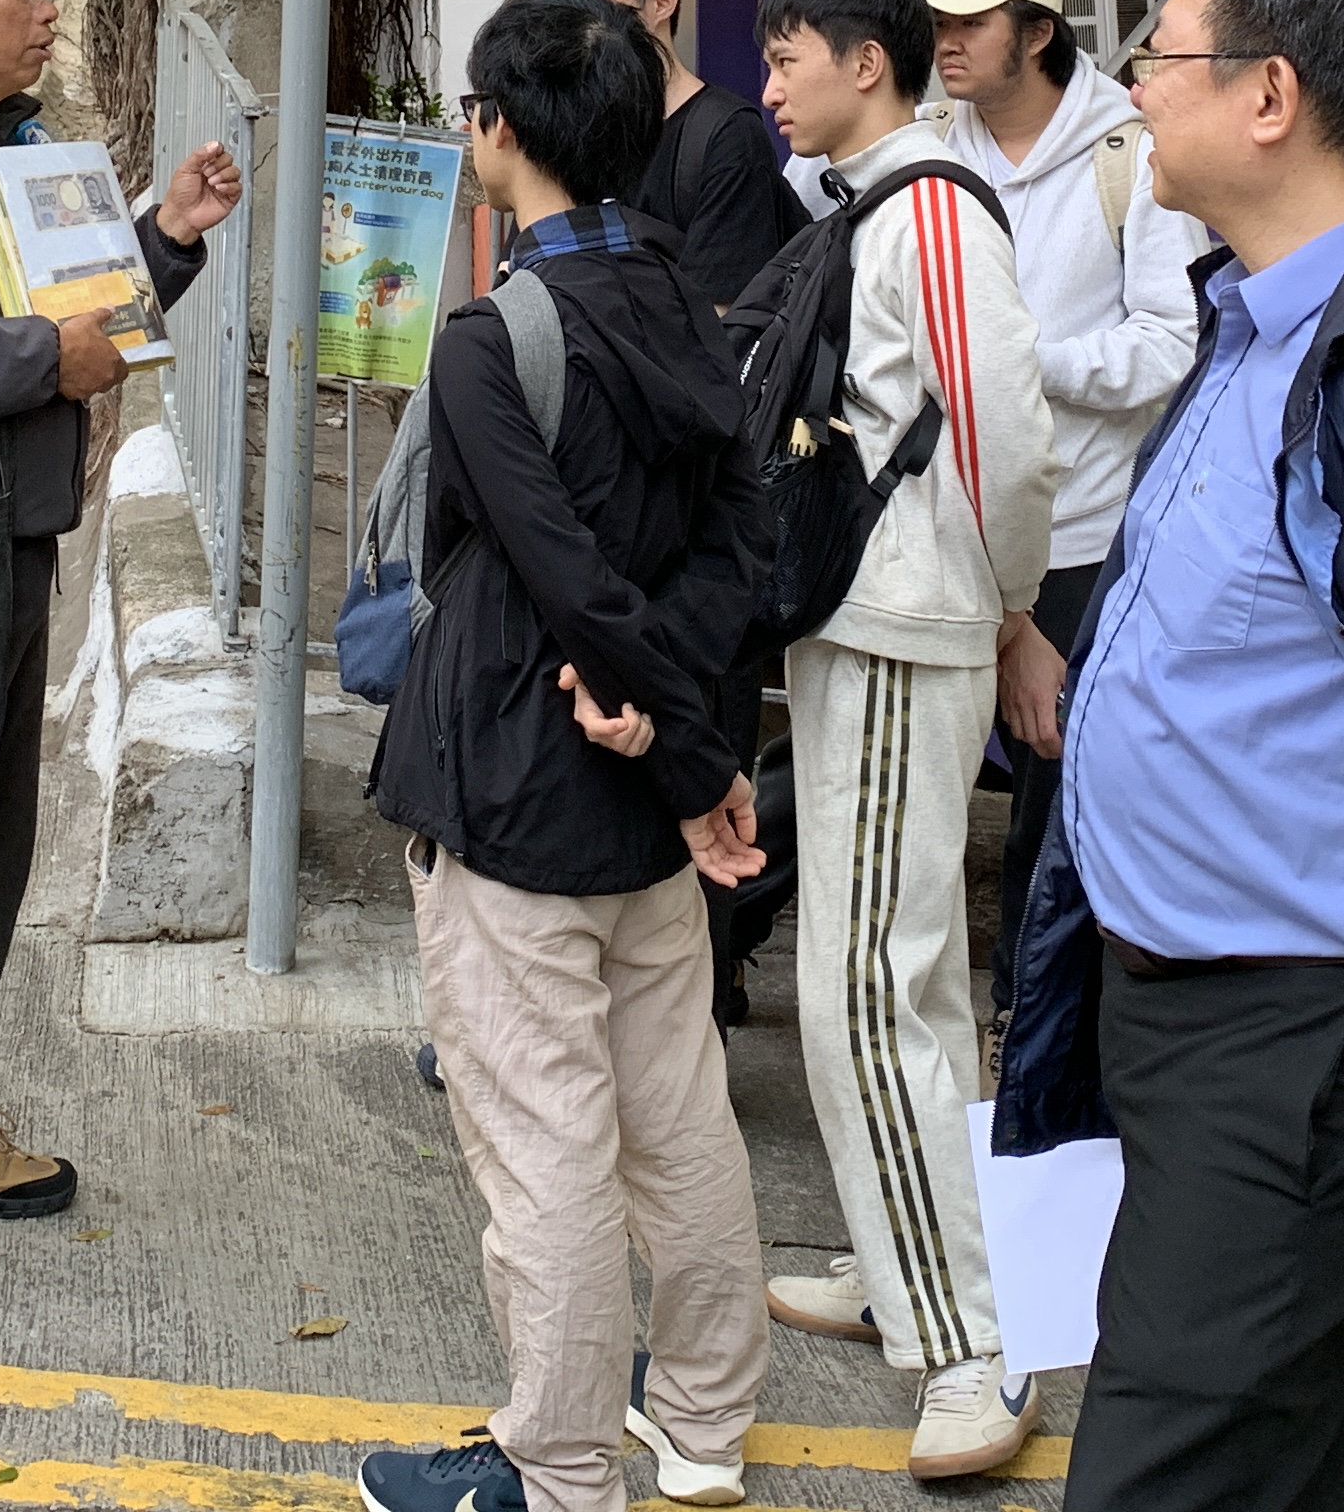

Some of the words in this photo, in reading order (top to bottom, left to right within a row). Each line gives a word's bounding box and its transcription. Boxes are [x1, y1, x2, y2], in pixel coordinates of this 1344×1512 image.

[334, 178, 351, 187] up
[354, 181, 388, 191] after
[389, 185, 418, 195] your
[421, 188, 444, 200] dog
